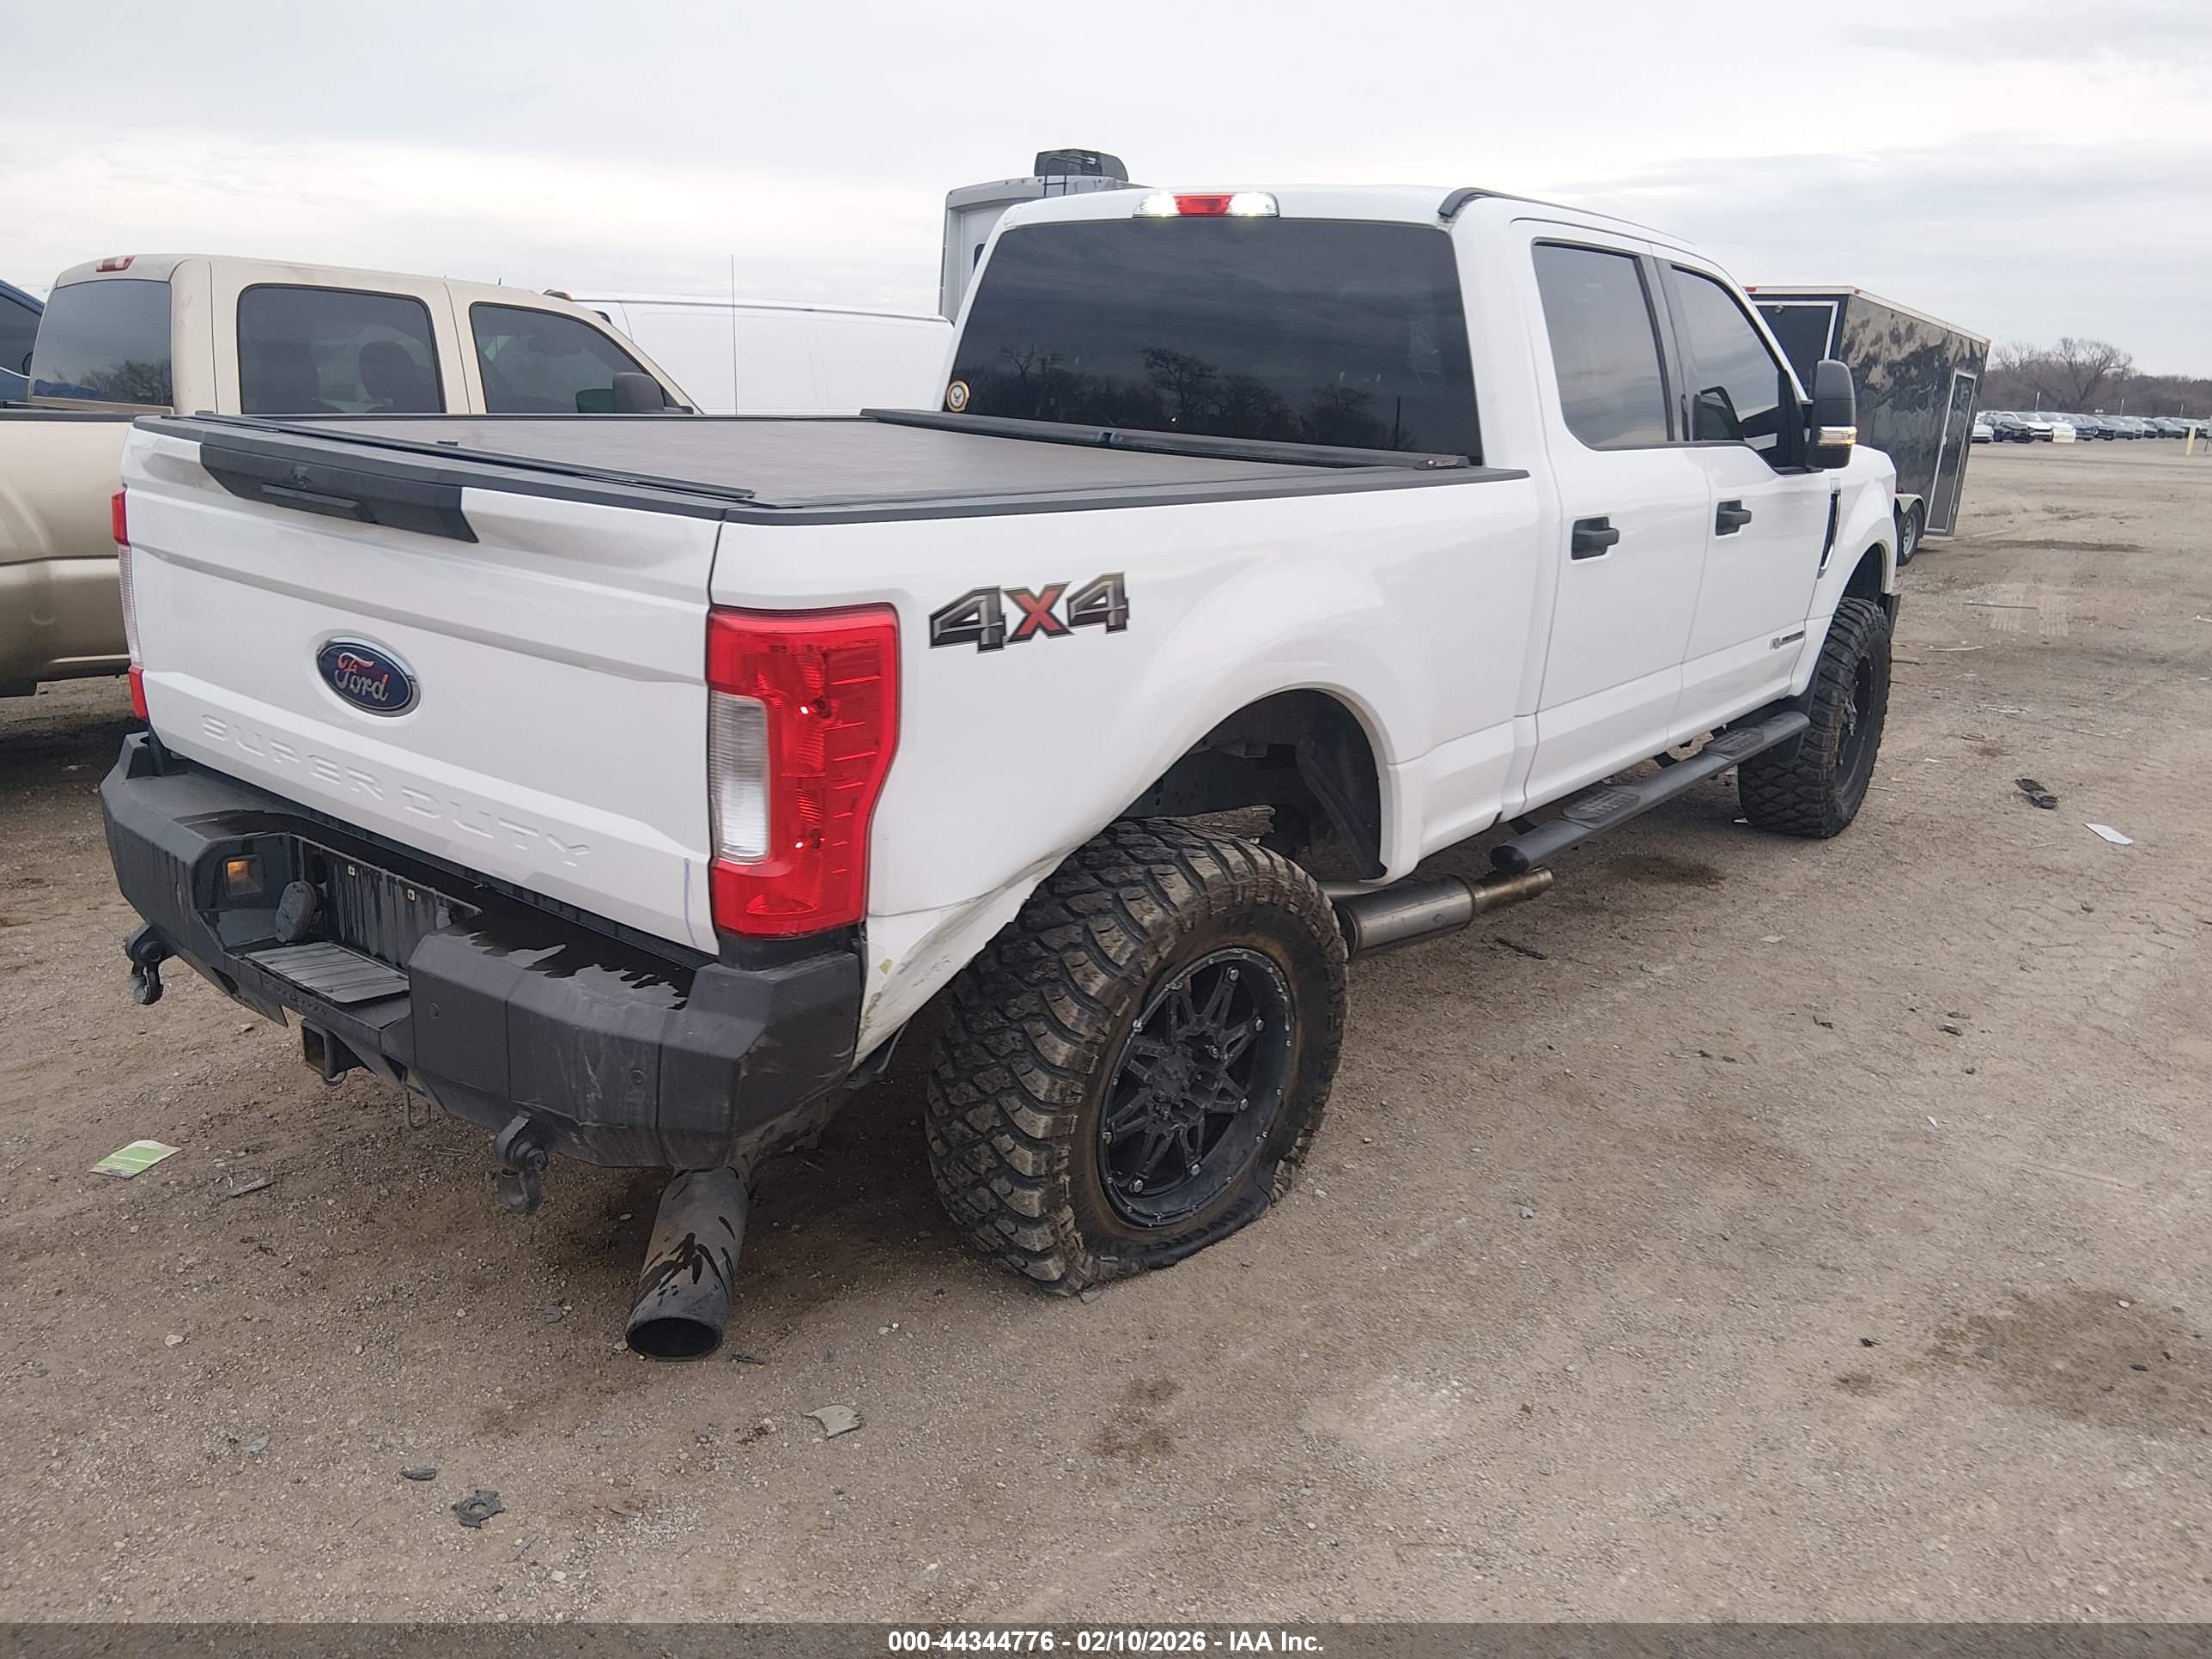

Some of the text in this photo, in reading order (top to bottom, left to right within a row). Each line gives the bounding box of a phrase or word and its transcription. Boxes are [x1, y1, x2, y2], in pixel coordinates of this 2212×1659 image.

[335, 652, 390, 702] Ford
[202, 714, 592, 867] SUPER DUTY
